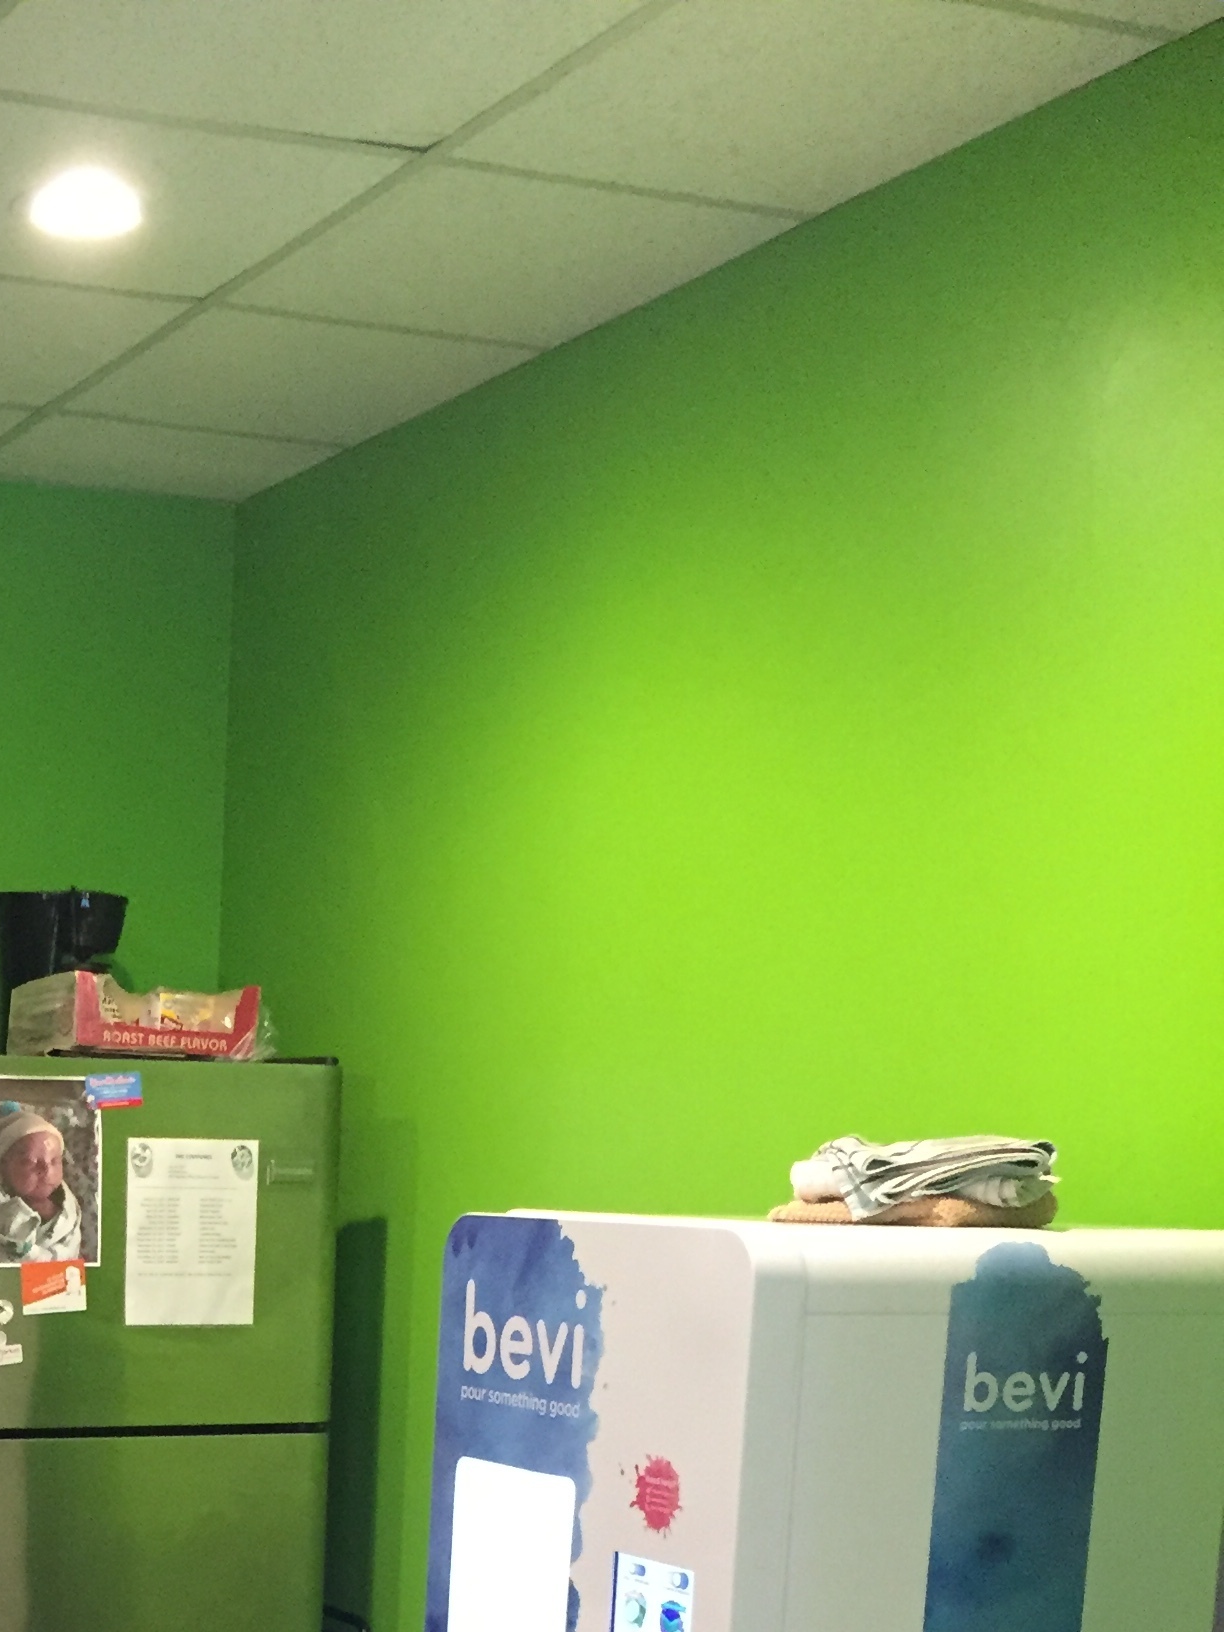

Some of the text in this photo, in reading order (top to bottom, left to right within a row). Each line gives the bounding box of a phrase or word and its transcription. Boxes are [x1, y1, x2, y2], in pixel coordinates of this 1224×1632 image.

[103, 1029, 228, 1052] ROAST BEEF FLAVOR
[463, 1278, 587, 1390] bevi
[963, 1351, 1088, 1412] bevi
[460, 1385, 581, 1418] pour something good
[1051, 1418, 1082, 1432] good
